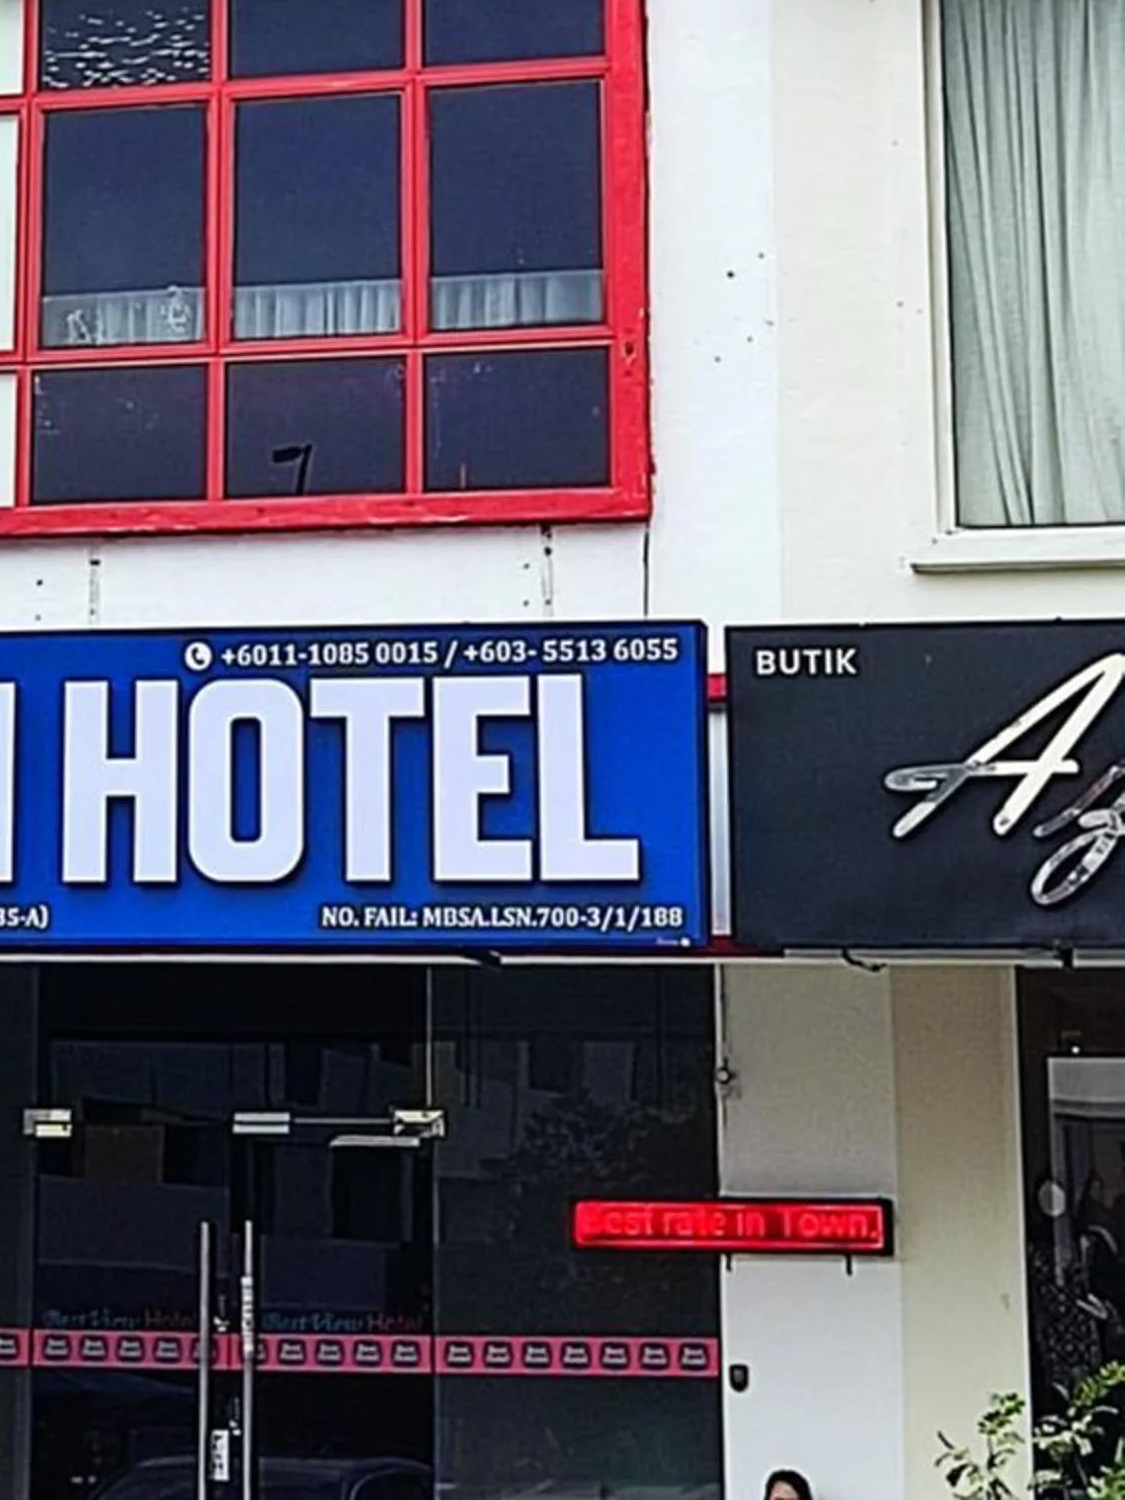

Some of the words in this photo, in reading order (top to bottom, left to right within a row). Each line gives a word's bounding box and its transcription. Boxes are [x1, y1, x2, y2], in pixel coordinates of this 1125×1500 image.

[221, 642, 369, 667] +6011-1085
[375, 642, 438, 665] 0015
[443, 641, 458, 669] /
[463, 641, 537, 663] +603-
[542, 639, 611, 662] 5513
[613, 638, 679, 661] 6055
[755, 648, 859, 676] BUTIK
[61, 674, 640, 884] HOTEL
[322, 907, 360, 928] NO.
[363, 907, 418, 928] FAIL:
[736, 1209, 766, 1238] in
